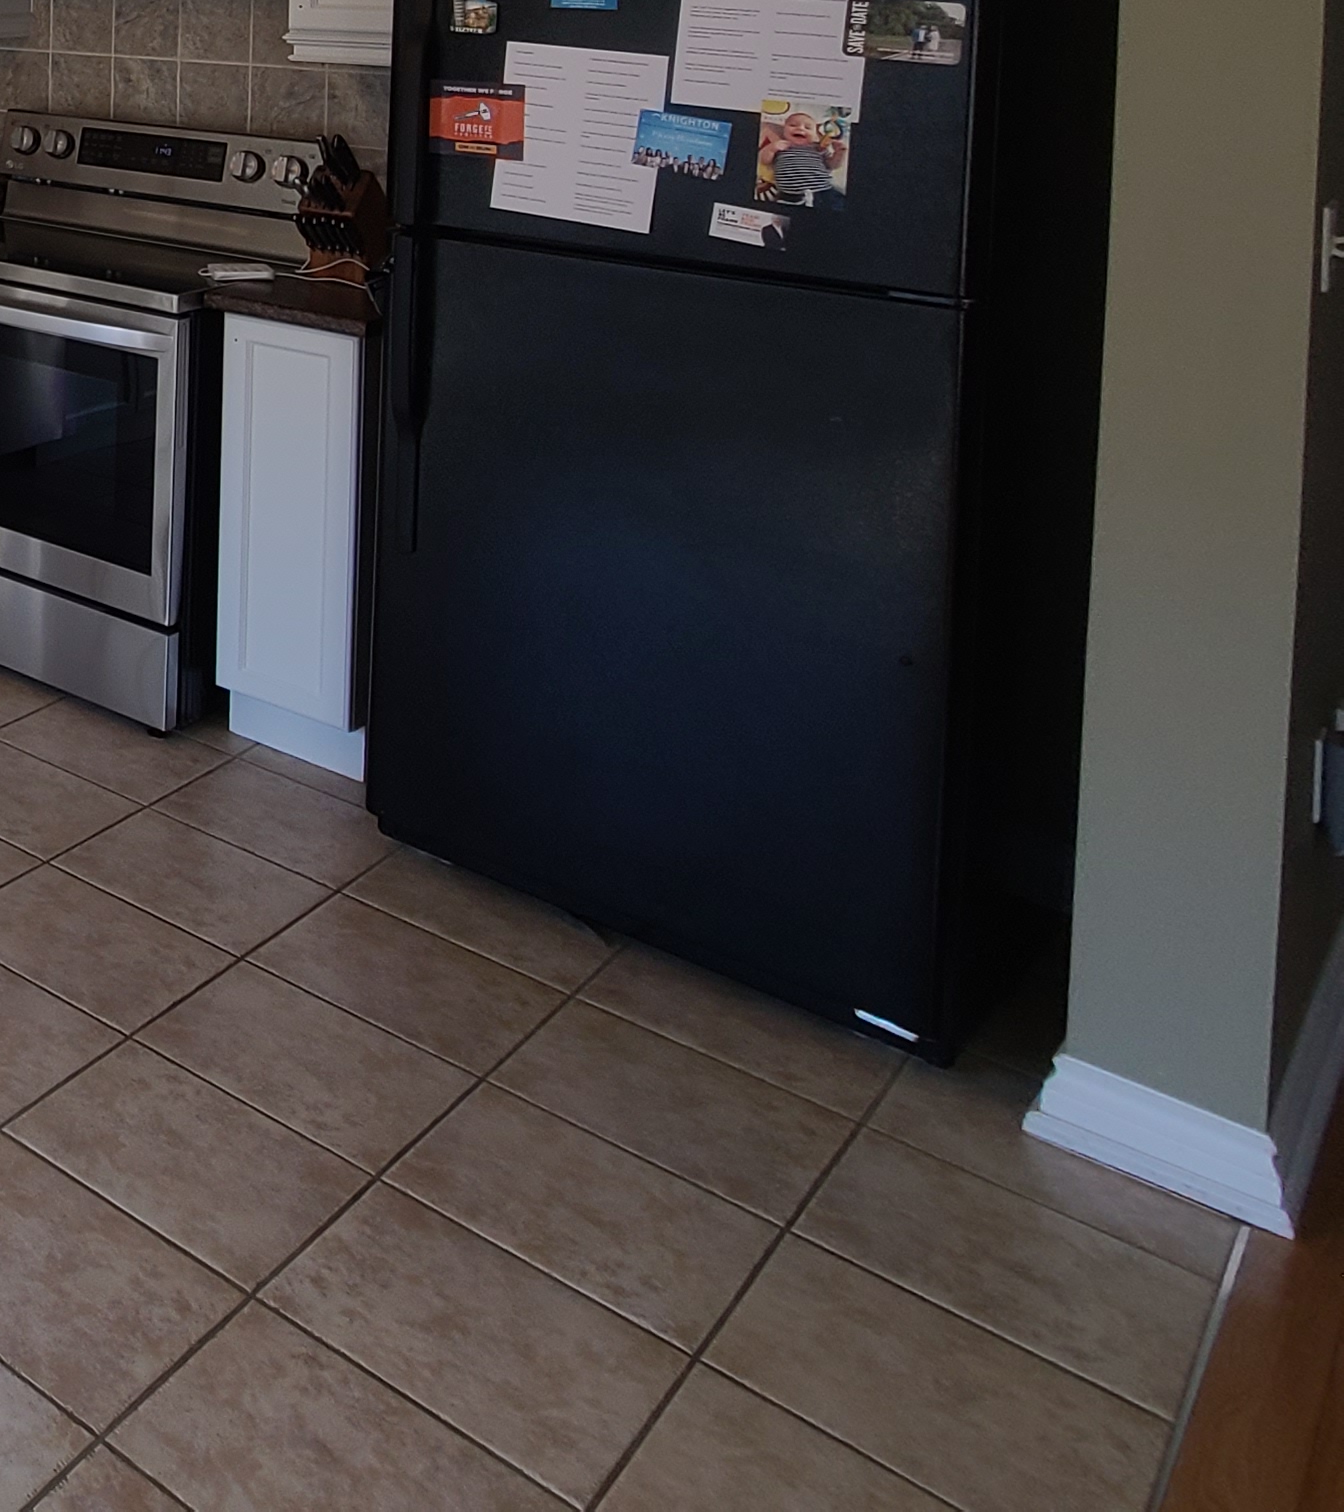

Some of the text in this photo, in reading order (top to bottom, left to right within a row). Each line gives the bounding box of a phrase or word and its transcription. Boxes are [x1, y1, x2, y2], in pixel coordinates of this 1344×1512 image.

[850, 1, 870, 25] DATE
[846, 30, 866, 54] SAVE
[454, 123, 484, 134] FORGE
[660, 113, 720, 131] KNIGHTON
